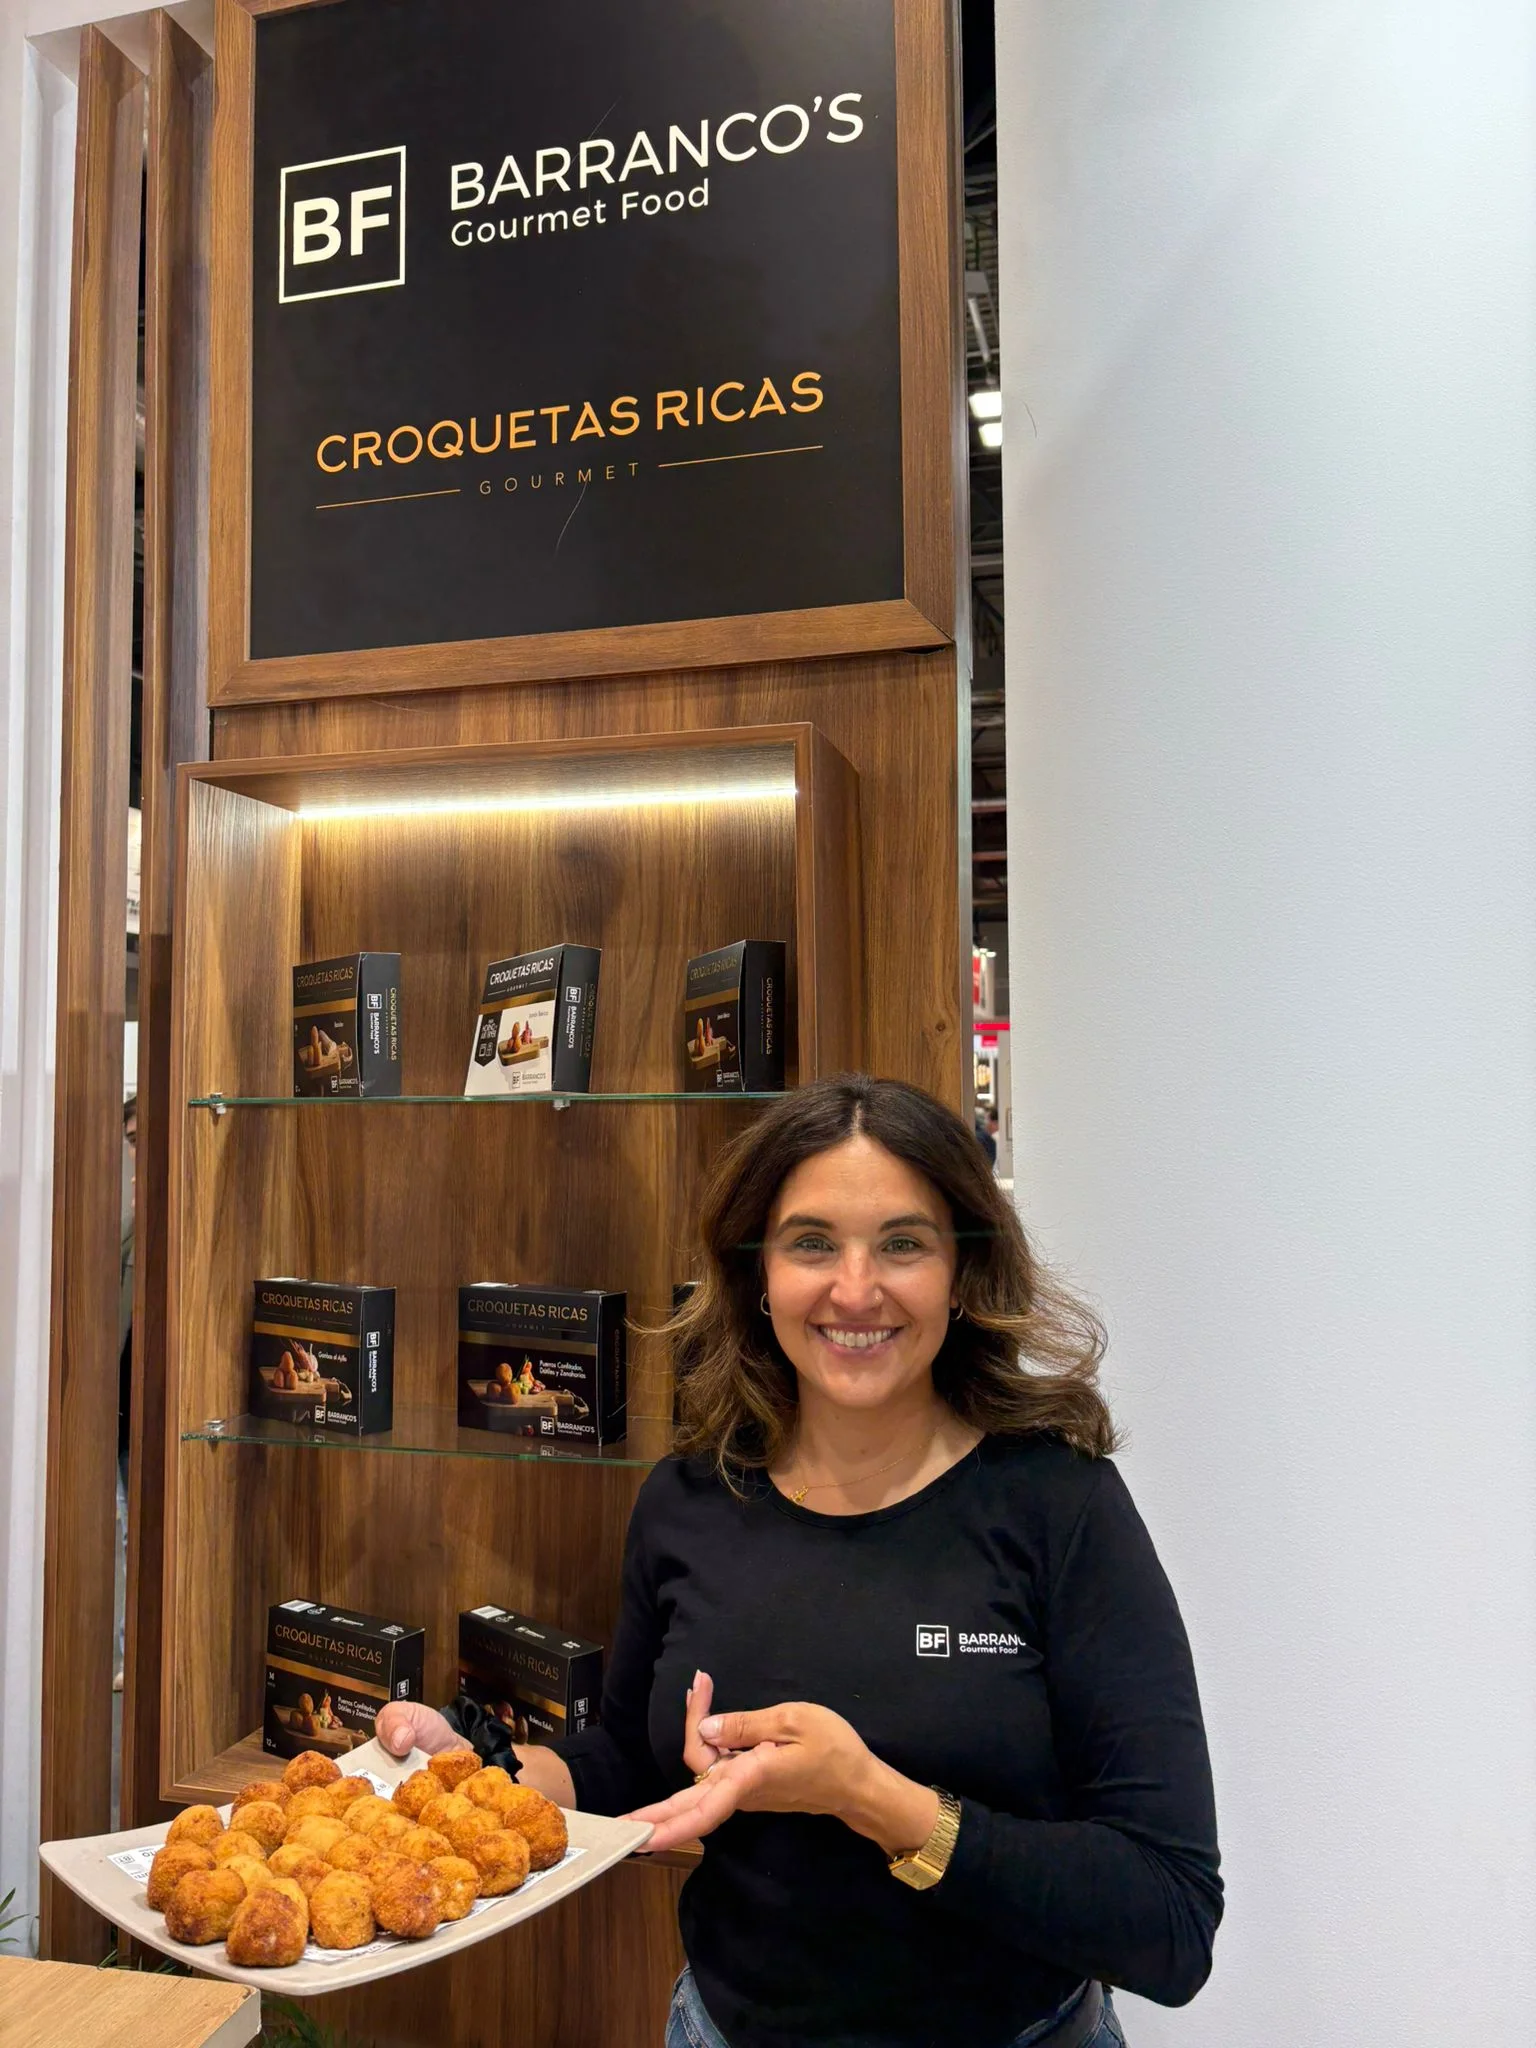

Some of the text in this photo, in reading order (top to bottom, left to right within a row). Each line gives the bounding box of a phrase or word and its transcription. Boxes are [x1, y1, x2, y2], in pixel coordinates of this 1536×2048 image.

[450, 92, 865, 211] BARRANCO'S
[292, 184, 392, 266] BF
[451, 178, 710, 247] Gourmet Food
[316, 371, 825, 473] CROQUETAS RICAS
[479, 462, 641, 495] GOURMET
[296, 966, 354, 988] CROQUETAS RICAS
[490, 958, 554, 986] CROQUETAS RICAS
[262, 1292, 353, 1314] CROQUETAS RICAS
[467, 1299, 588, 1321] CROQUETAS RICAS
[275, 1624, 383, 1665] CROQUETAS RICAS
[919, 1632, 946, 1649] BF
[960, 1645, 1018, 1654] Gourmet Food
[527, 1656, 560, 1681] RICAS
